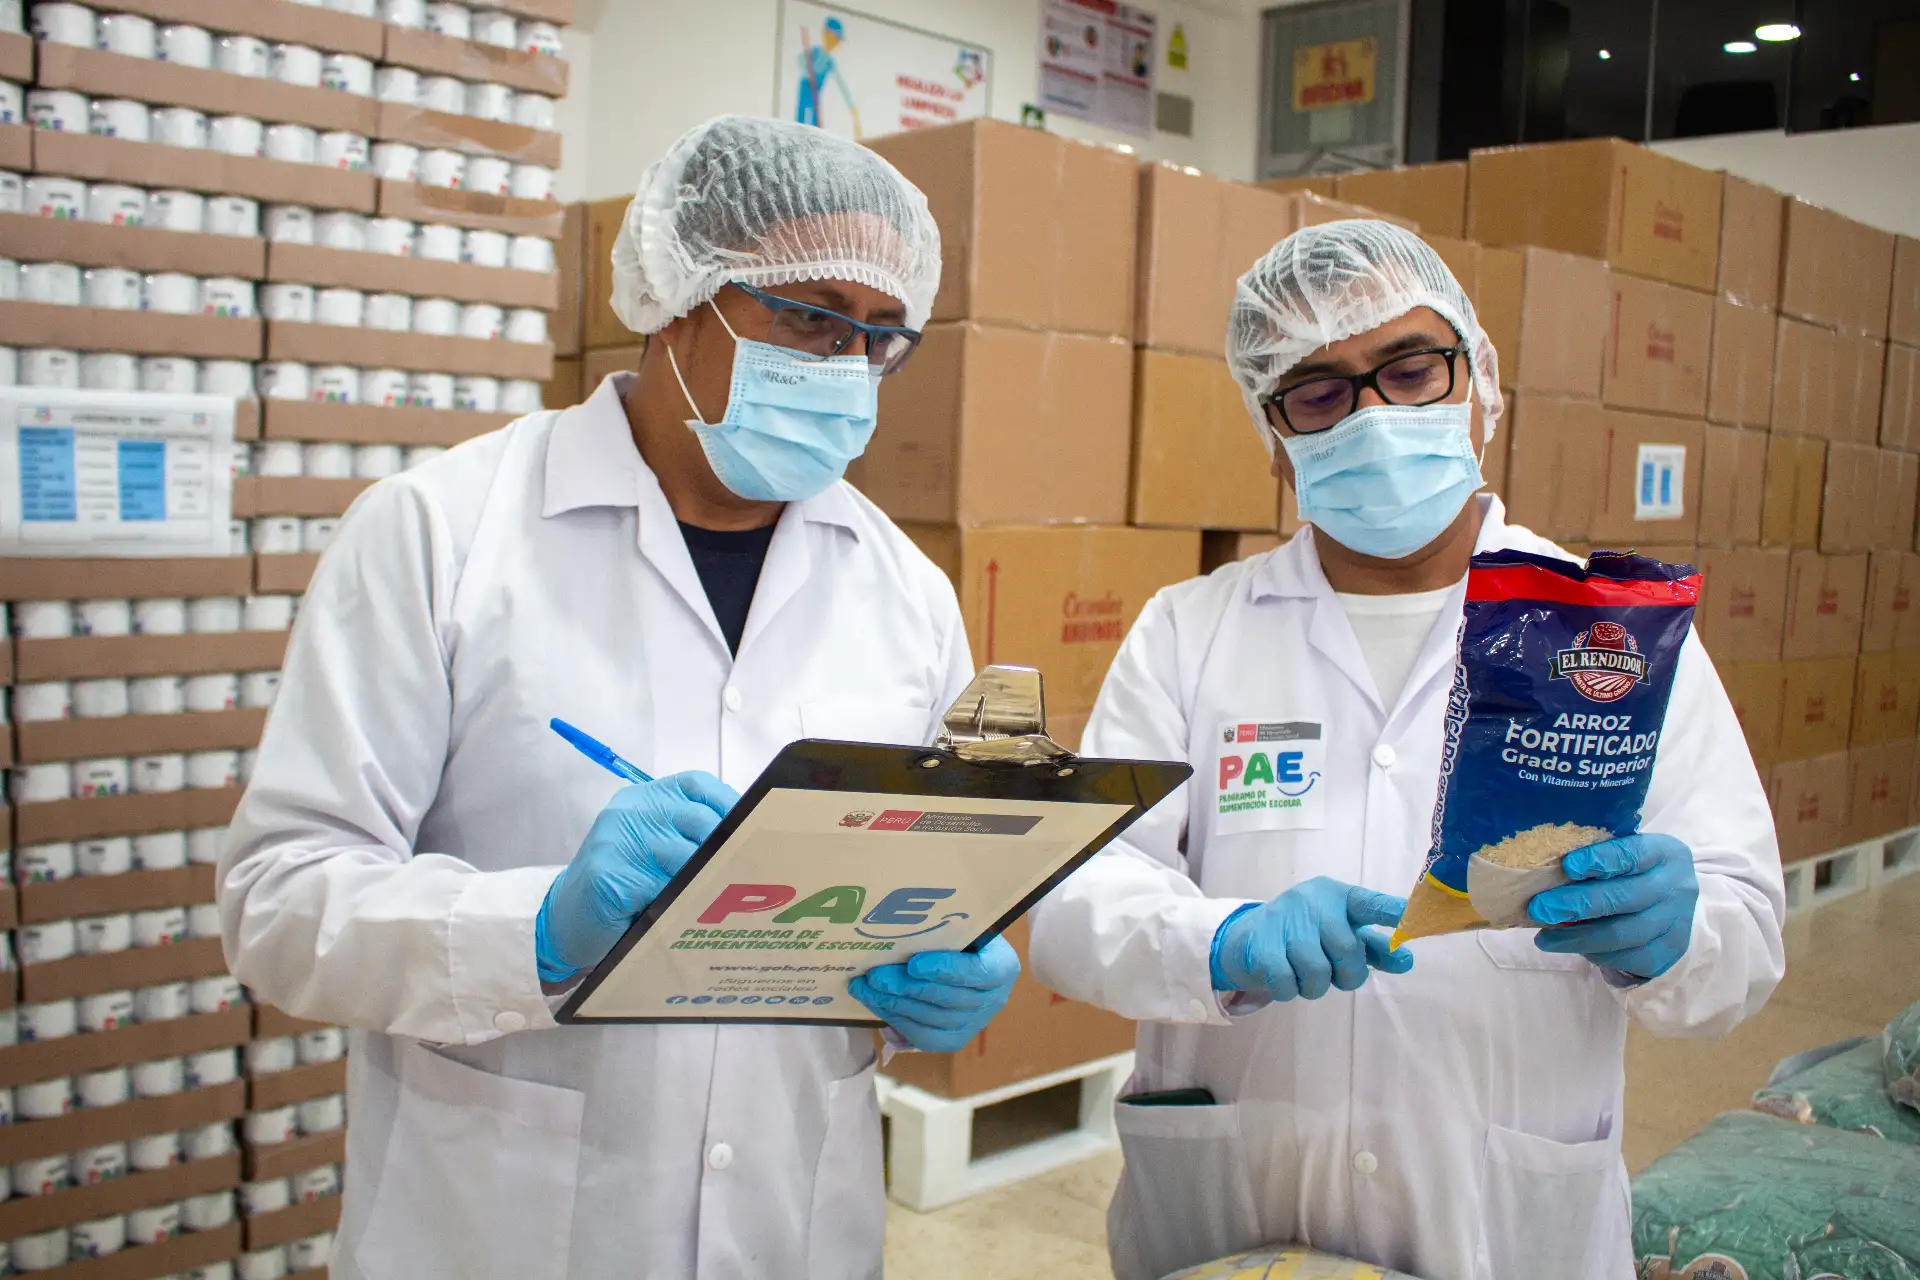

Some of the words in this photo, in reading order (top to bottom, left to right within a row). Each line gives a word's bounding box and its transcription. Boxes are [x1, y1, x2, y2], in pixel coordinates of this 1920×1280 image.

[1562, 653, 1578, 669] EL
[1580, 652, 1641, 675] RENDIDOR
[1552, 713, 1632, 731] ARROZ
[1504, 723, 1657, 756] FORTIFICADO
[1501, 748, 1572, 773] Grado
[1577, 755, 1651, 778] Superior
[1219, 751, 1303, 790] PAE
[1518, 769, 1539, 782] Con
[1542, 774, 1589, 788] Vitaminas
[1591, 780, 1598, 790] y
[1599, 776, 1635, 789] Minerales
[1257, 790, 1266, 799] DE
[1269, 798, 1302, 808] ESCOLAR
[880, 816, 912, 825] PERÚ
[925, 813, 972, 821] Ministerio
[697, 884, 956, 924] PAE
[679, 929, 796, 939] PROGRAMA
[797, 930, 824, 940] DE
[814, 941, 896, 951] ESCOLAR
[709, 965, 857, 973] www.gob.pe/pae
